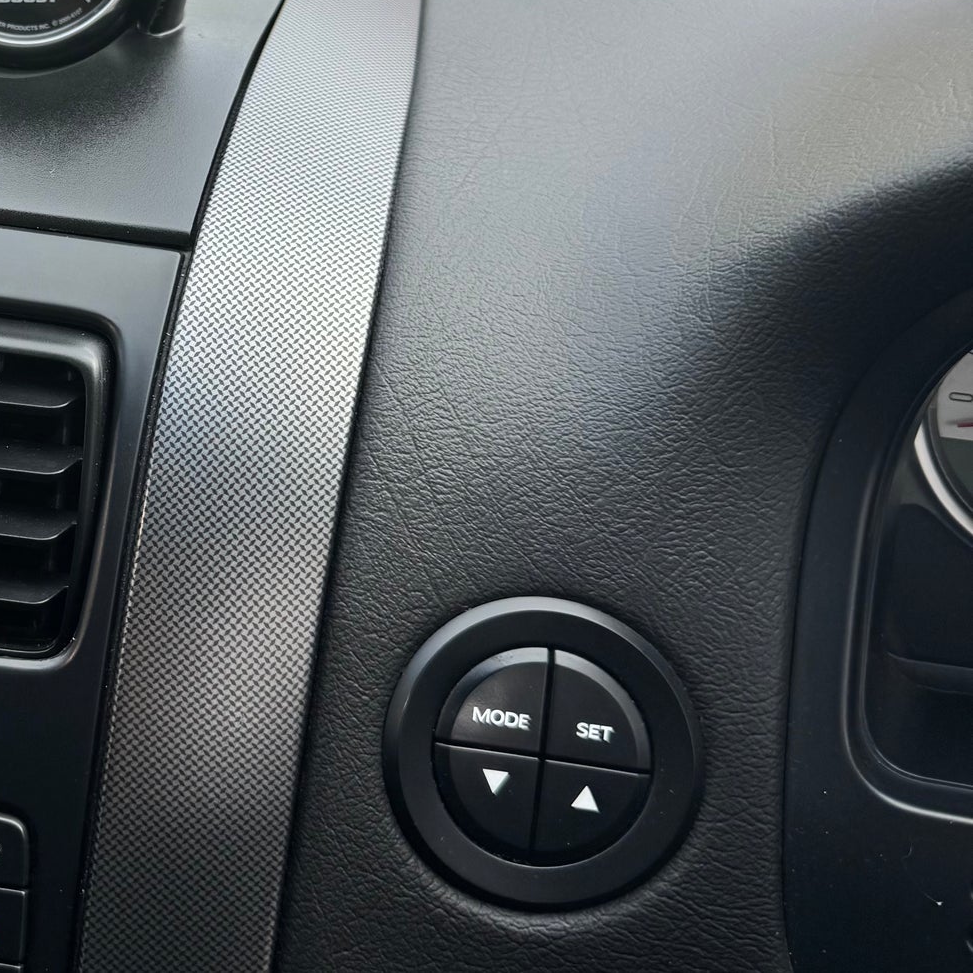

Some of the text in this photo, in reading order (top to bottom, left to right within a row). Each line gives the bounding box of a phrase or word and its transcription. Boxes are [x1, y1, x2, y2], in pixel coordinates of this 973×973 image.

[7, 23, 38, 31] PRODUCTS
[472, 706, 531, 731] MODE
[575, 721, 615, 743] SET
